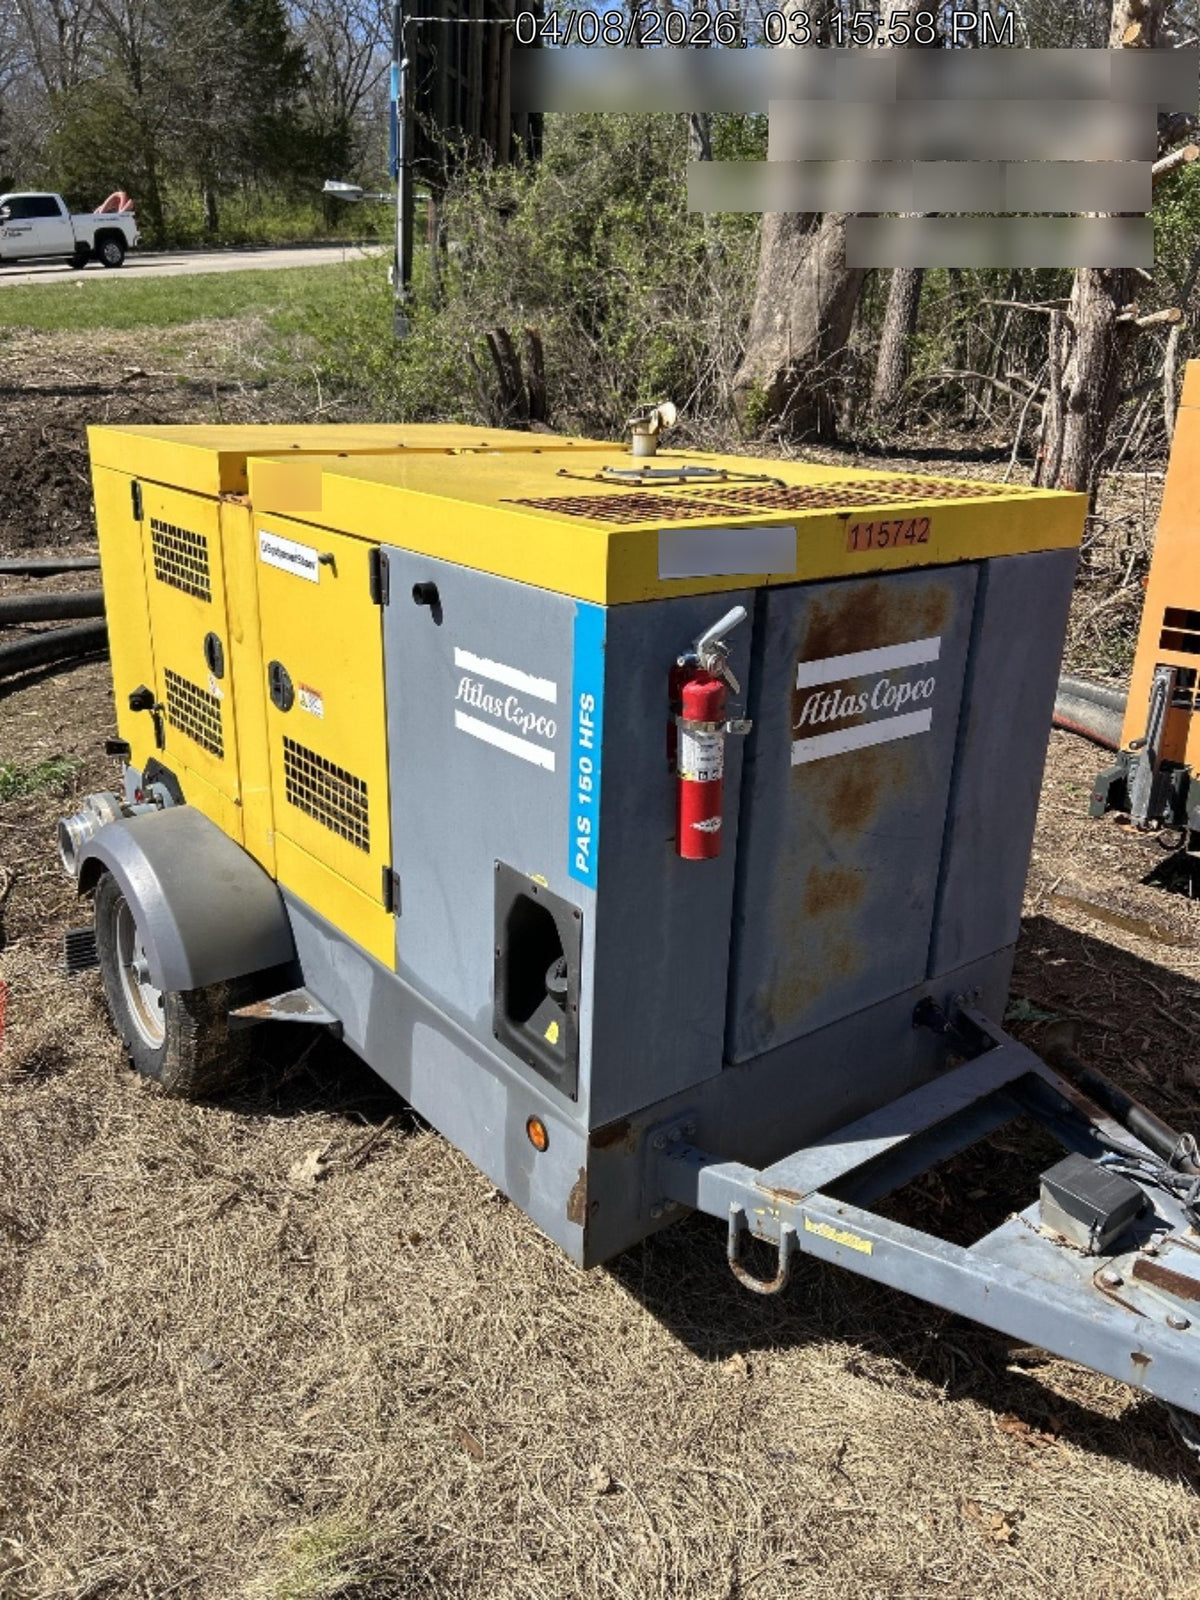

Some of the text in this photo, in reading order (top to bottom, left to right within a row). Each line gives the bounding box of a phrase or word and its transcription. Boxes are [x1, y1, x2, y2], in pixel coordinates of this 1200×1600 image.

[851, 517, 929, 550] 115742
[455, 677, 557, 739] Atlas Copco
[792, 676, 936, 730] Atlas Copco
[575, 692, 595, 873] PAS 150 HFS
